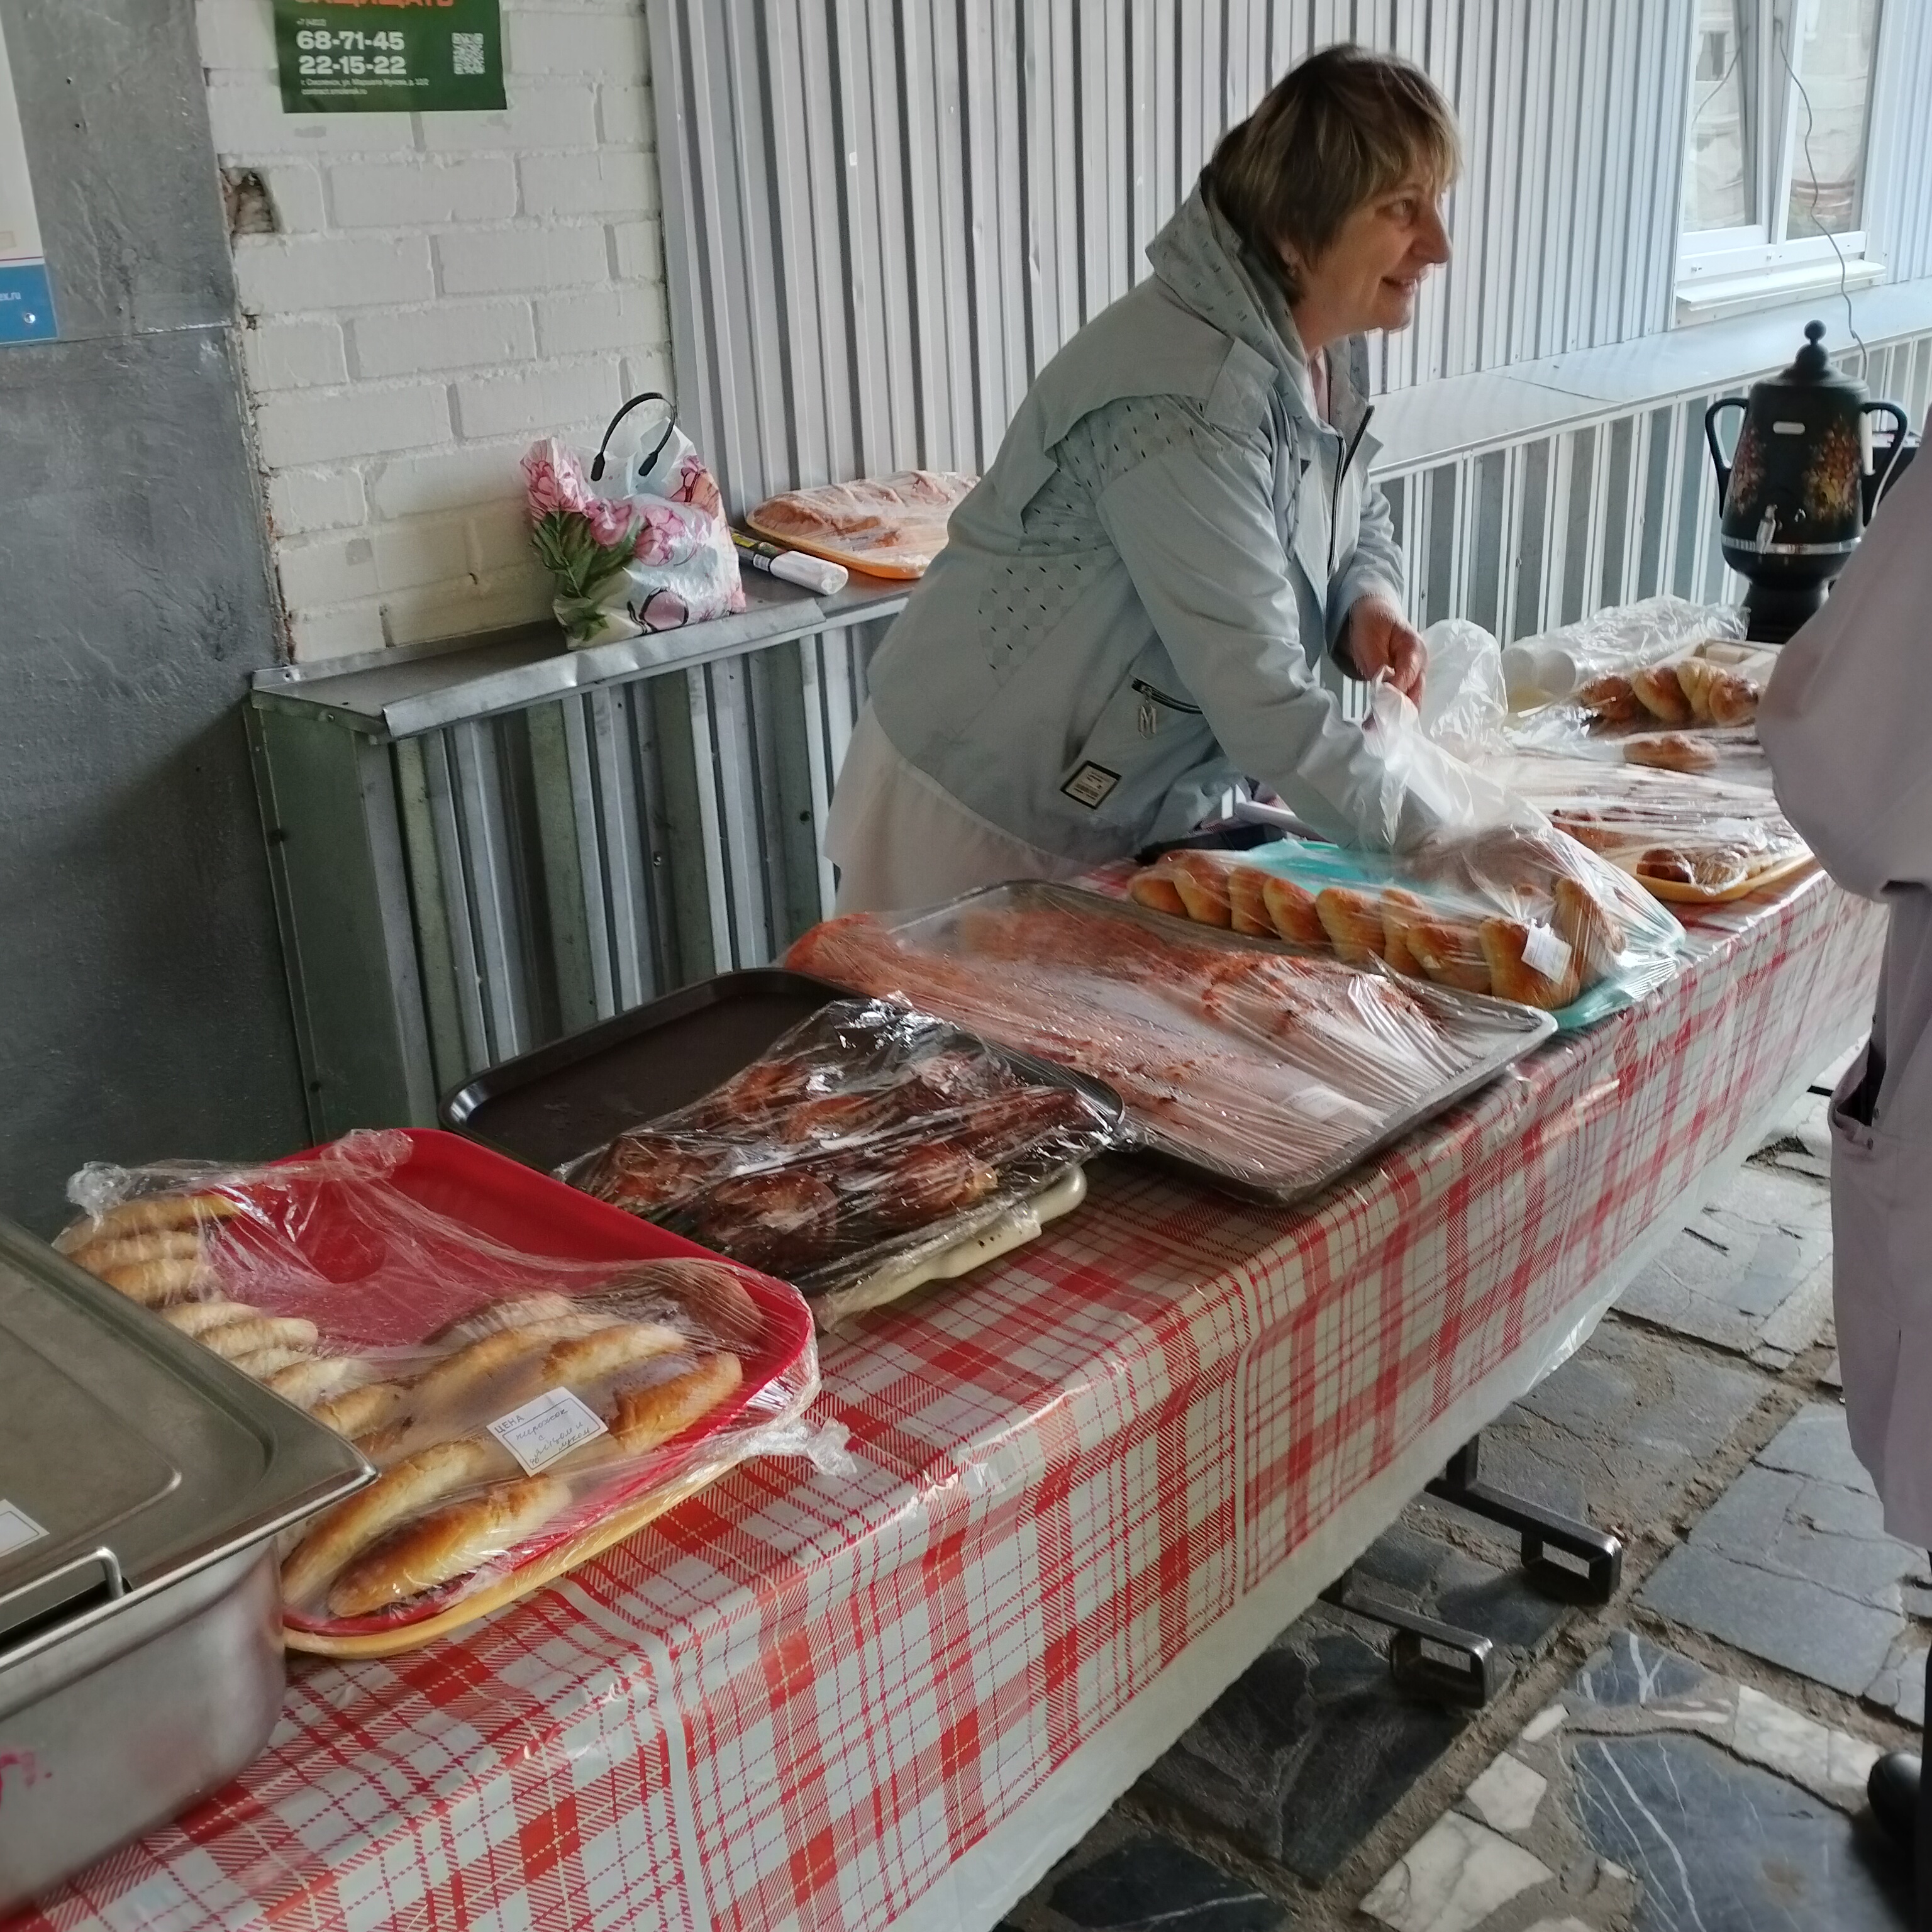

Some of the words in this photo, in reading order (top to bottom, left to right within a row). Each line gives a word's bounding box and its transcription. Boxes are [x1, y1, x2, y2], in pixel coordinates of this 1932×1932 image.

[296, 30, 405, 50] 68-71-45
[299, 55, 407, 74] 22-15-22
[494, 1415, 525, 1434] ЦЕНА
